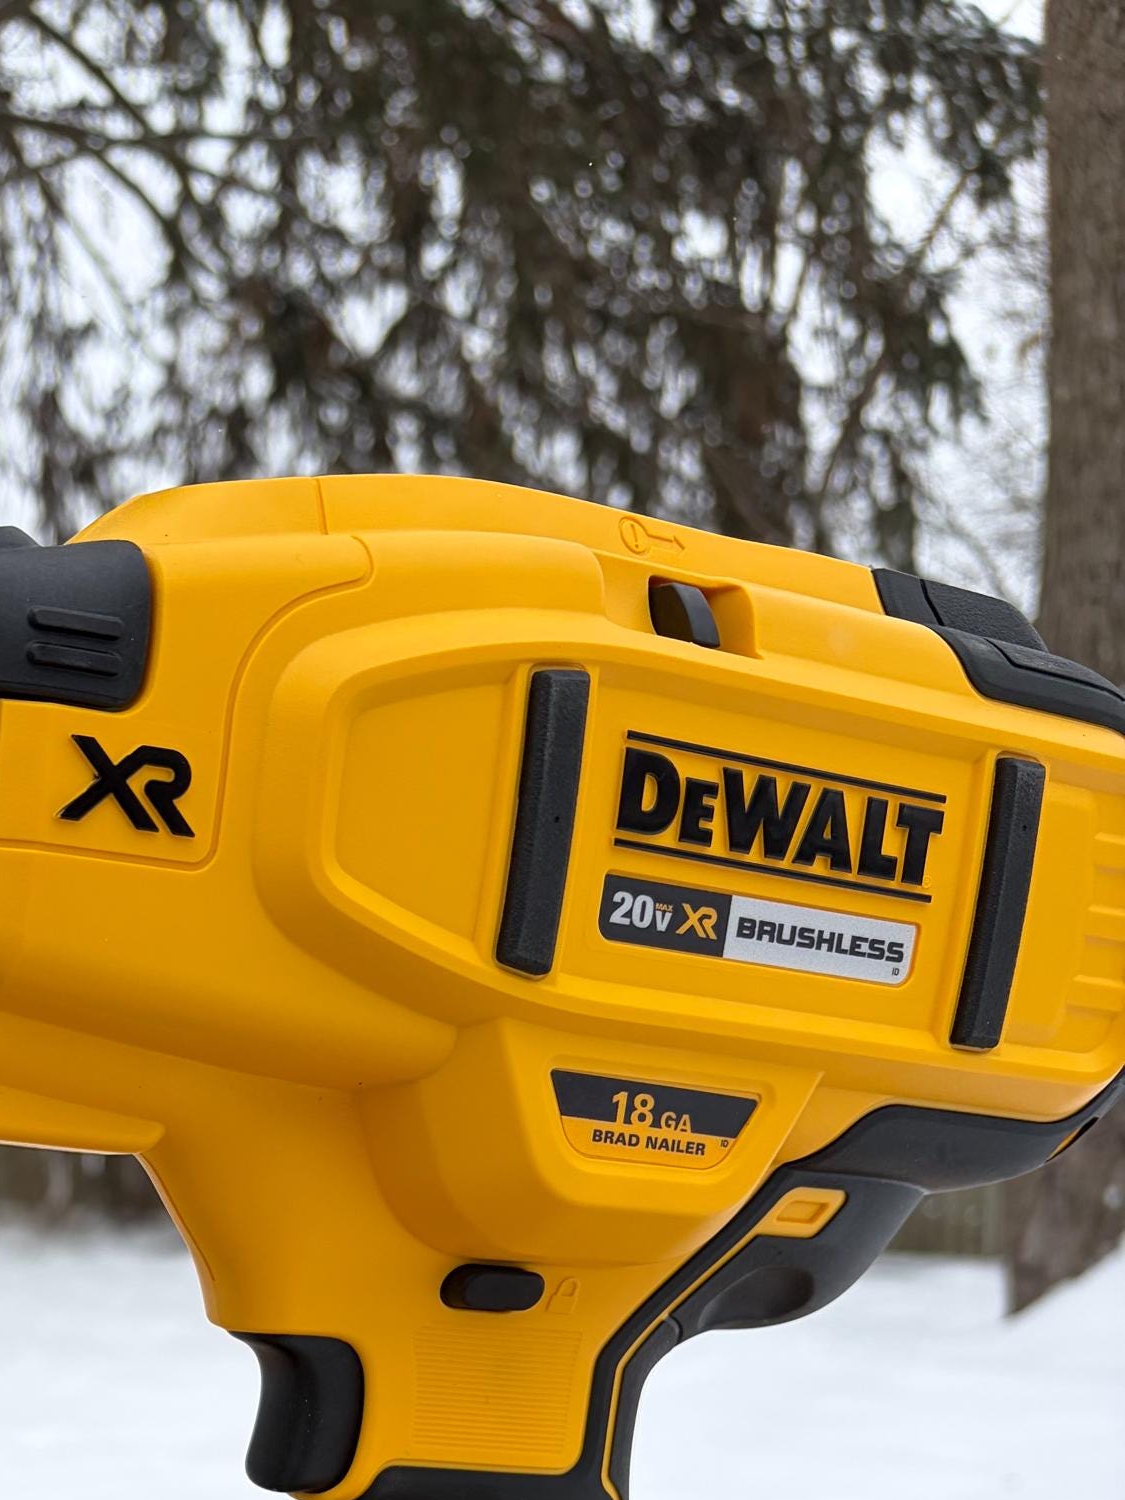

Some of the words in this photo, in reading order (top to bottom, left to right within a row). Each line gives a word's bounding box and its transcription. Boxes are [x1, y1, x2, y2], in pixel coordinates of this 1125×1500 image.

[58, 734, 195, 837] XR
[655, 902, 673, 913] MAX
[675, 902, 718, 940] XR
[736, 916, 904, 963] BRUSHLESS
[611, 1091, 655, 1128] 18
[660, 1111, 692, 1134] GA
[592, 1129, 640, 1147] BRAD
[645, 1136, 706, 1156] NAILER
